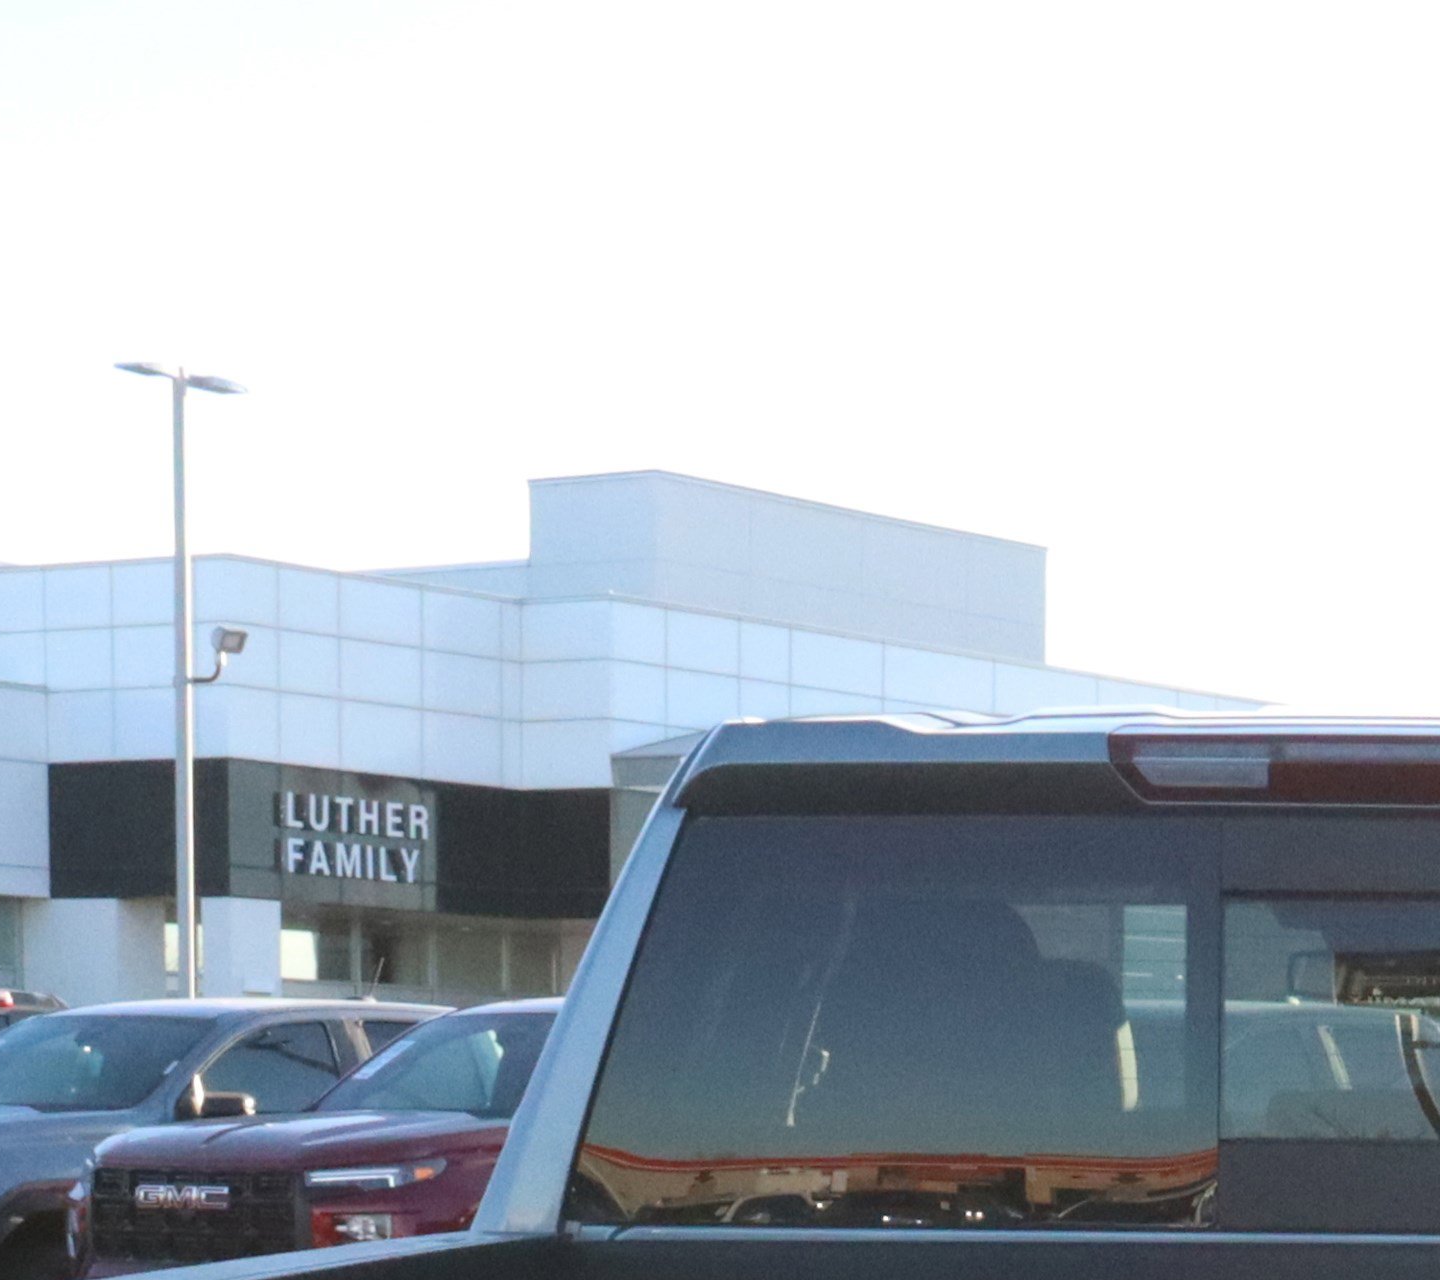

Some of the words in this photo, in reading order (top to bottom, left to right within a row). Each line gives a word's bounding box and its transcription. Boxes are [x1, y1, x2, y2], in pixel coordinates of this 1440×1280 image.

[286, 792, 429, 840] LUTHER
[287, 838, 420, 884] FAMILY
[135, 1184, 229, 1210] GMC
